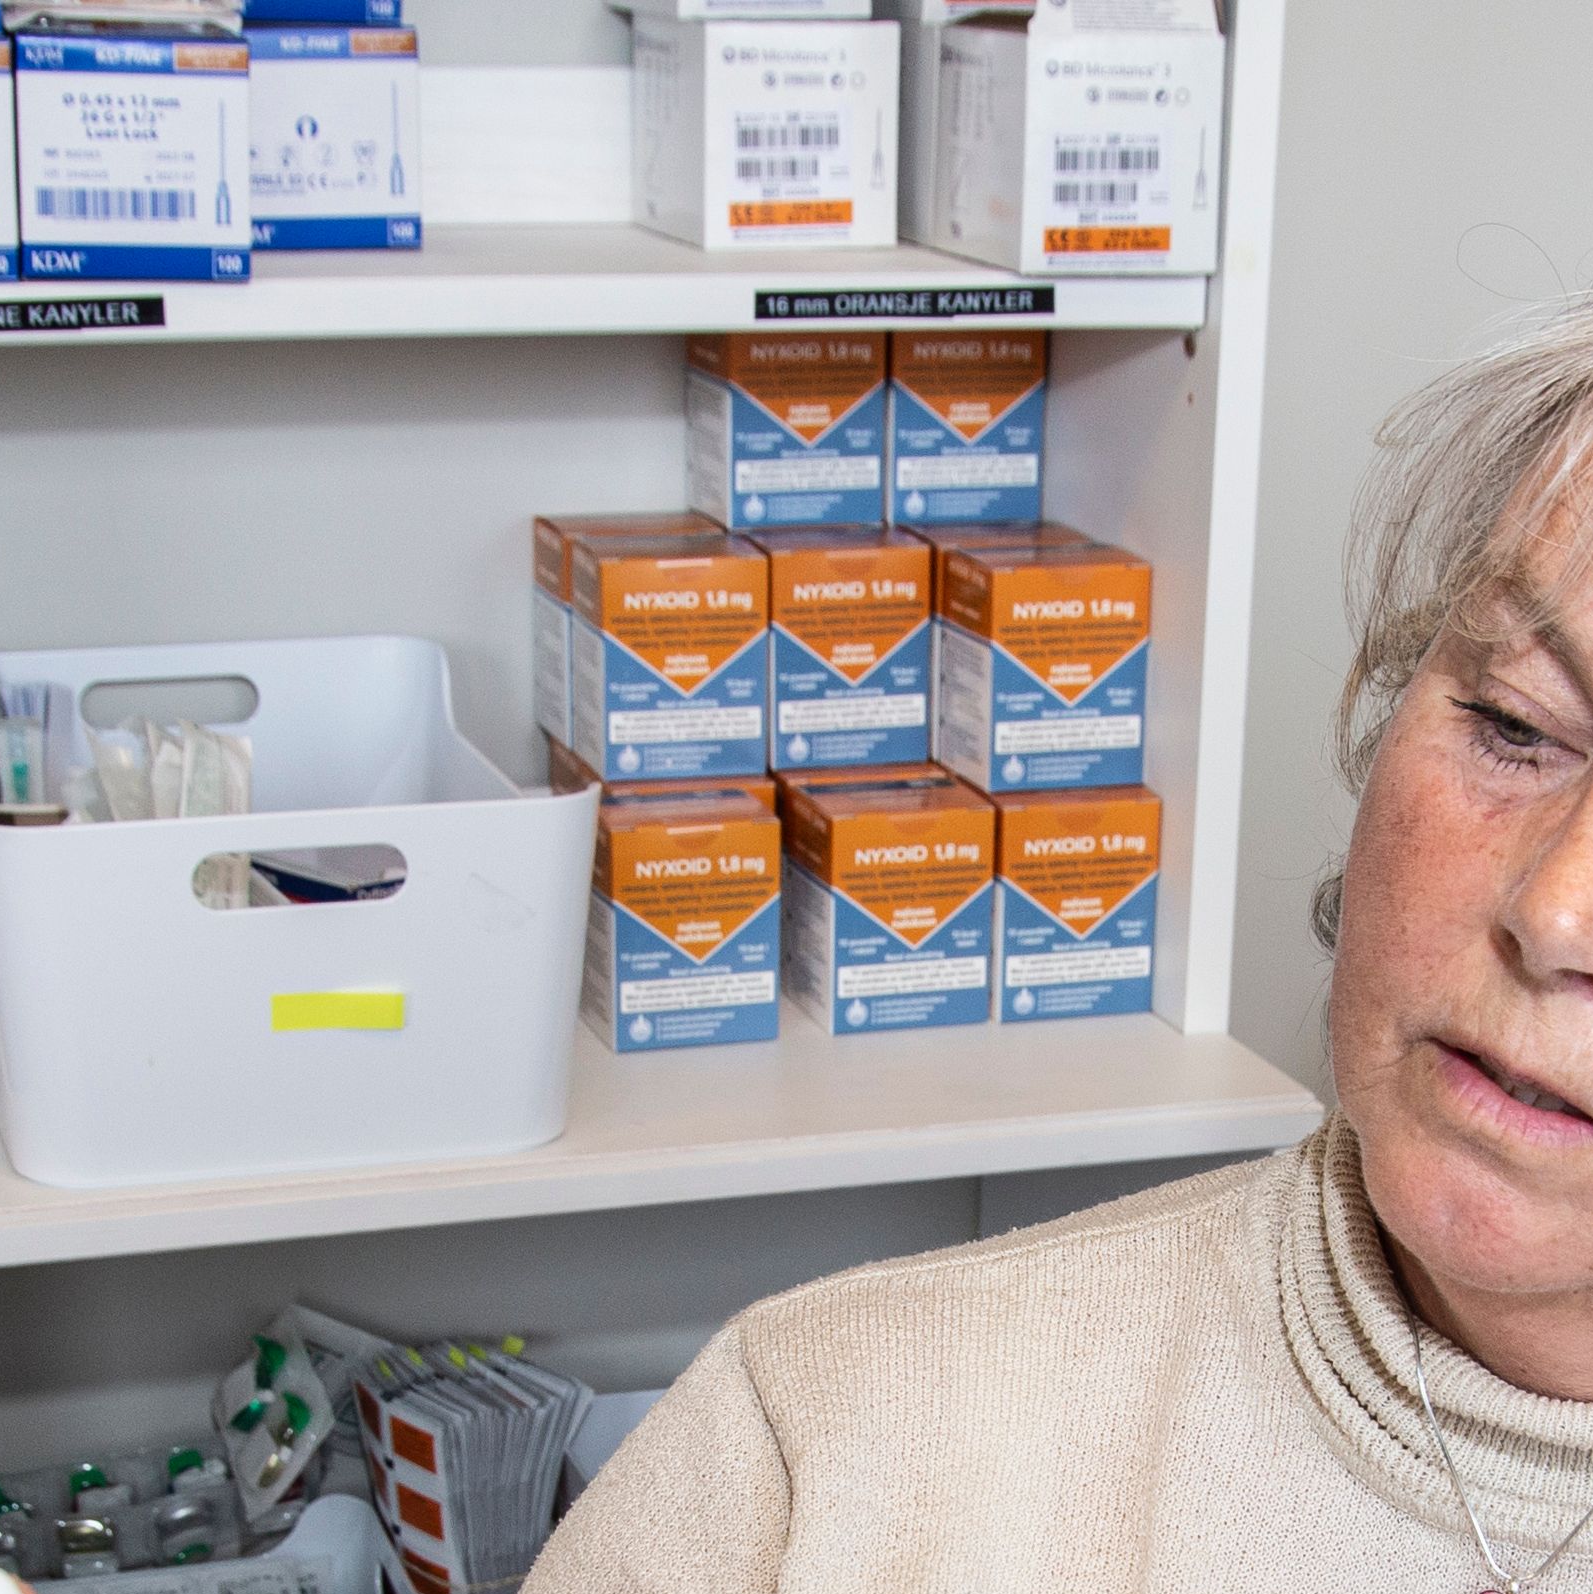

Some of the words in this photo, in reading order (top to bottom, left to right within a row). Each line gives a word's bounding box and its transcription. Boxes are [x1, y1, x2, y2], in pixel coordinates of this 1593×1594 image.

[31, 250, 81, 273] KDM
[28, 301, 141, 327] KANYLER
[765, 295, 790, 317] 16
[793, 297, 830, 316] mm
[834, 291, 933, 317] ORANSJE
[937, 290, 1034, 313] KANYLER
[623, 590, 701, 610] NYXOID
[793, 580, 867, 601] NYXOID
[1012, 599, 1086, 620] NYXOID
[854, 844, 929, 865] NYXOID
[1024, 835, 1097, 856] NYXOID
[634, 856, 712, 879] NYXOID
